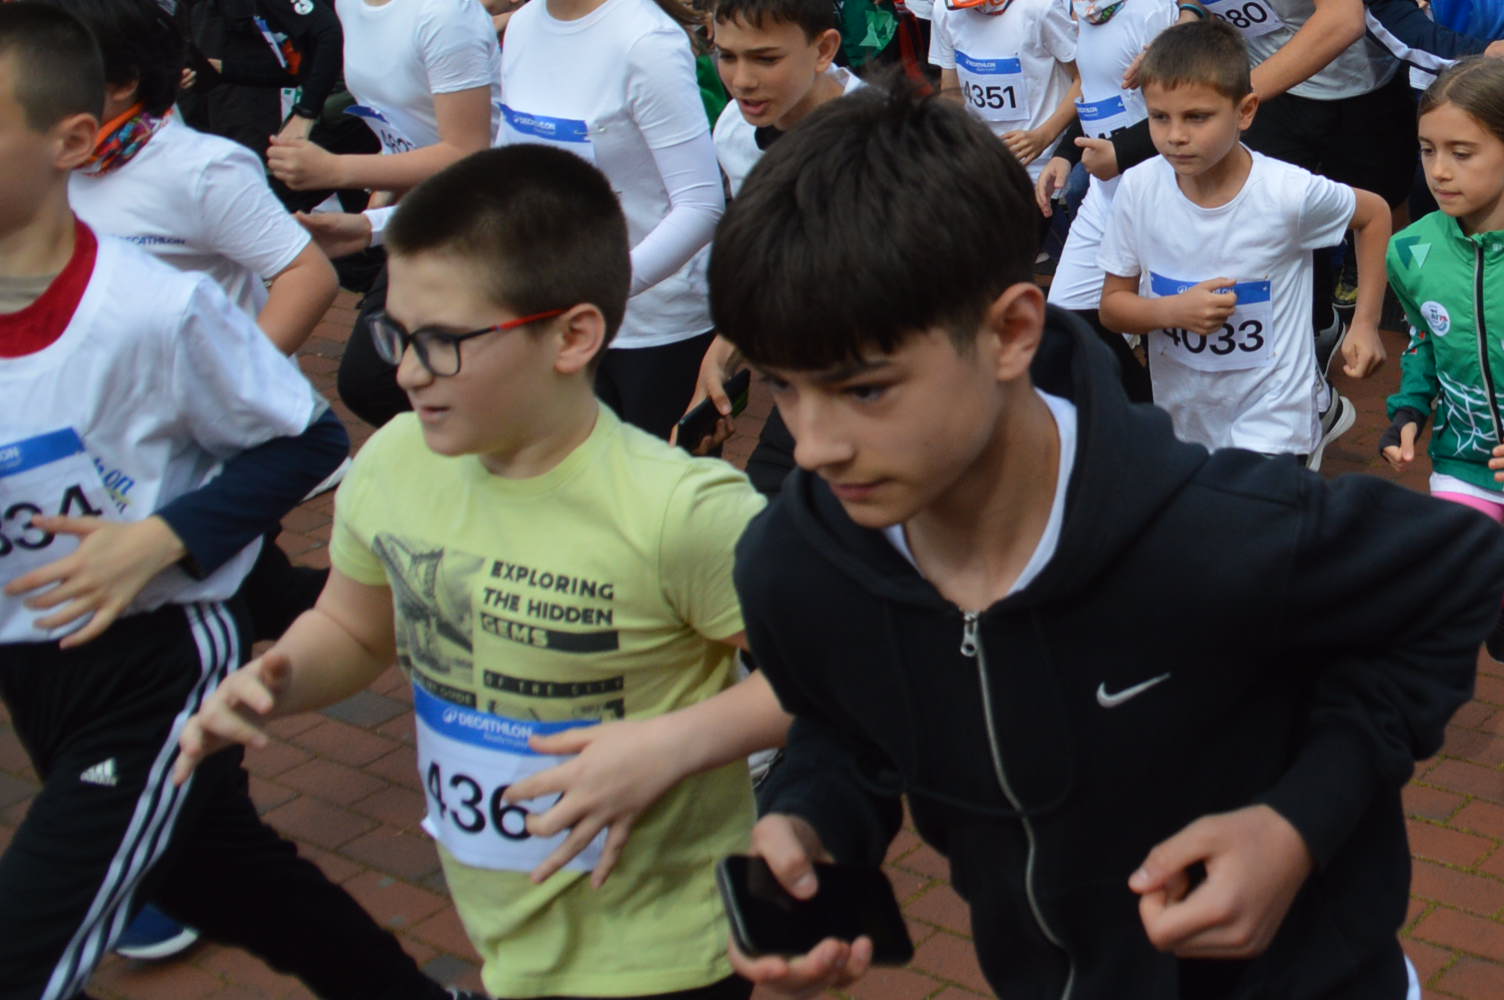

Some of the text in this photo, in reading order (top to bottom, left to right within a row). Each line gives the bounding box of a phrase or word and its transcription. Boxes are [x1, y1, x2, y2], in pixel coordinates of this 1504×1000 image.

[964, 81, 1016, 109] 4351
[1163, 319, 1265, 356] 4033
[0, 484, 104, 558] 34
[489, 560, 615, 601] EXPLORING
[483, 587, 614, 626] THE HIDDEN
[479, 612, 549, 649] GEMS
[457, 711, 534, 739] DECATHLON
[427, 760, 536, 842] 436
